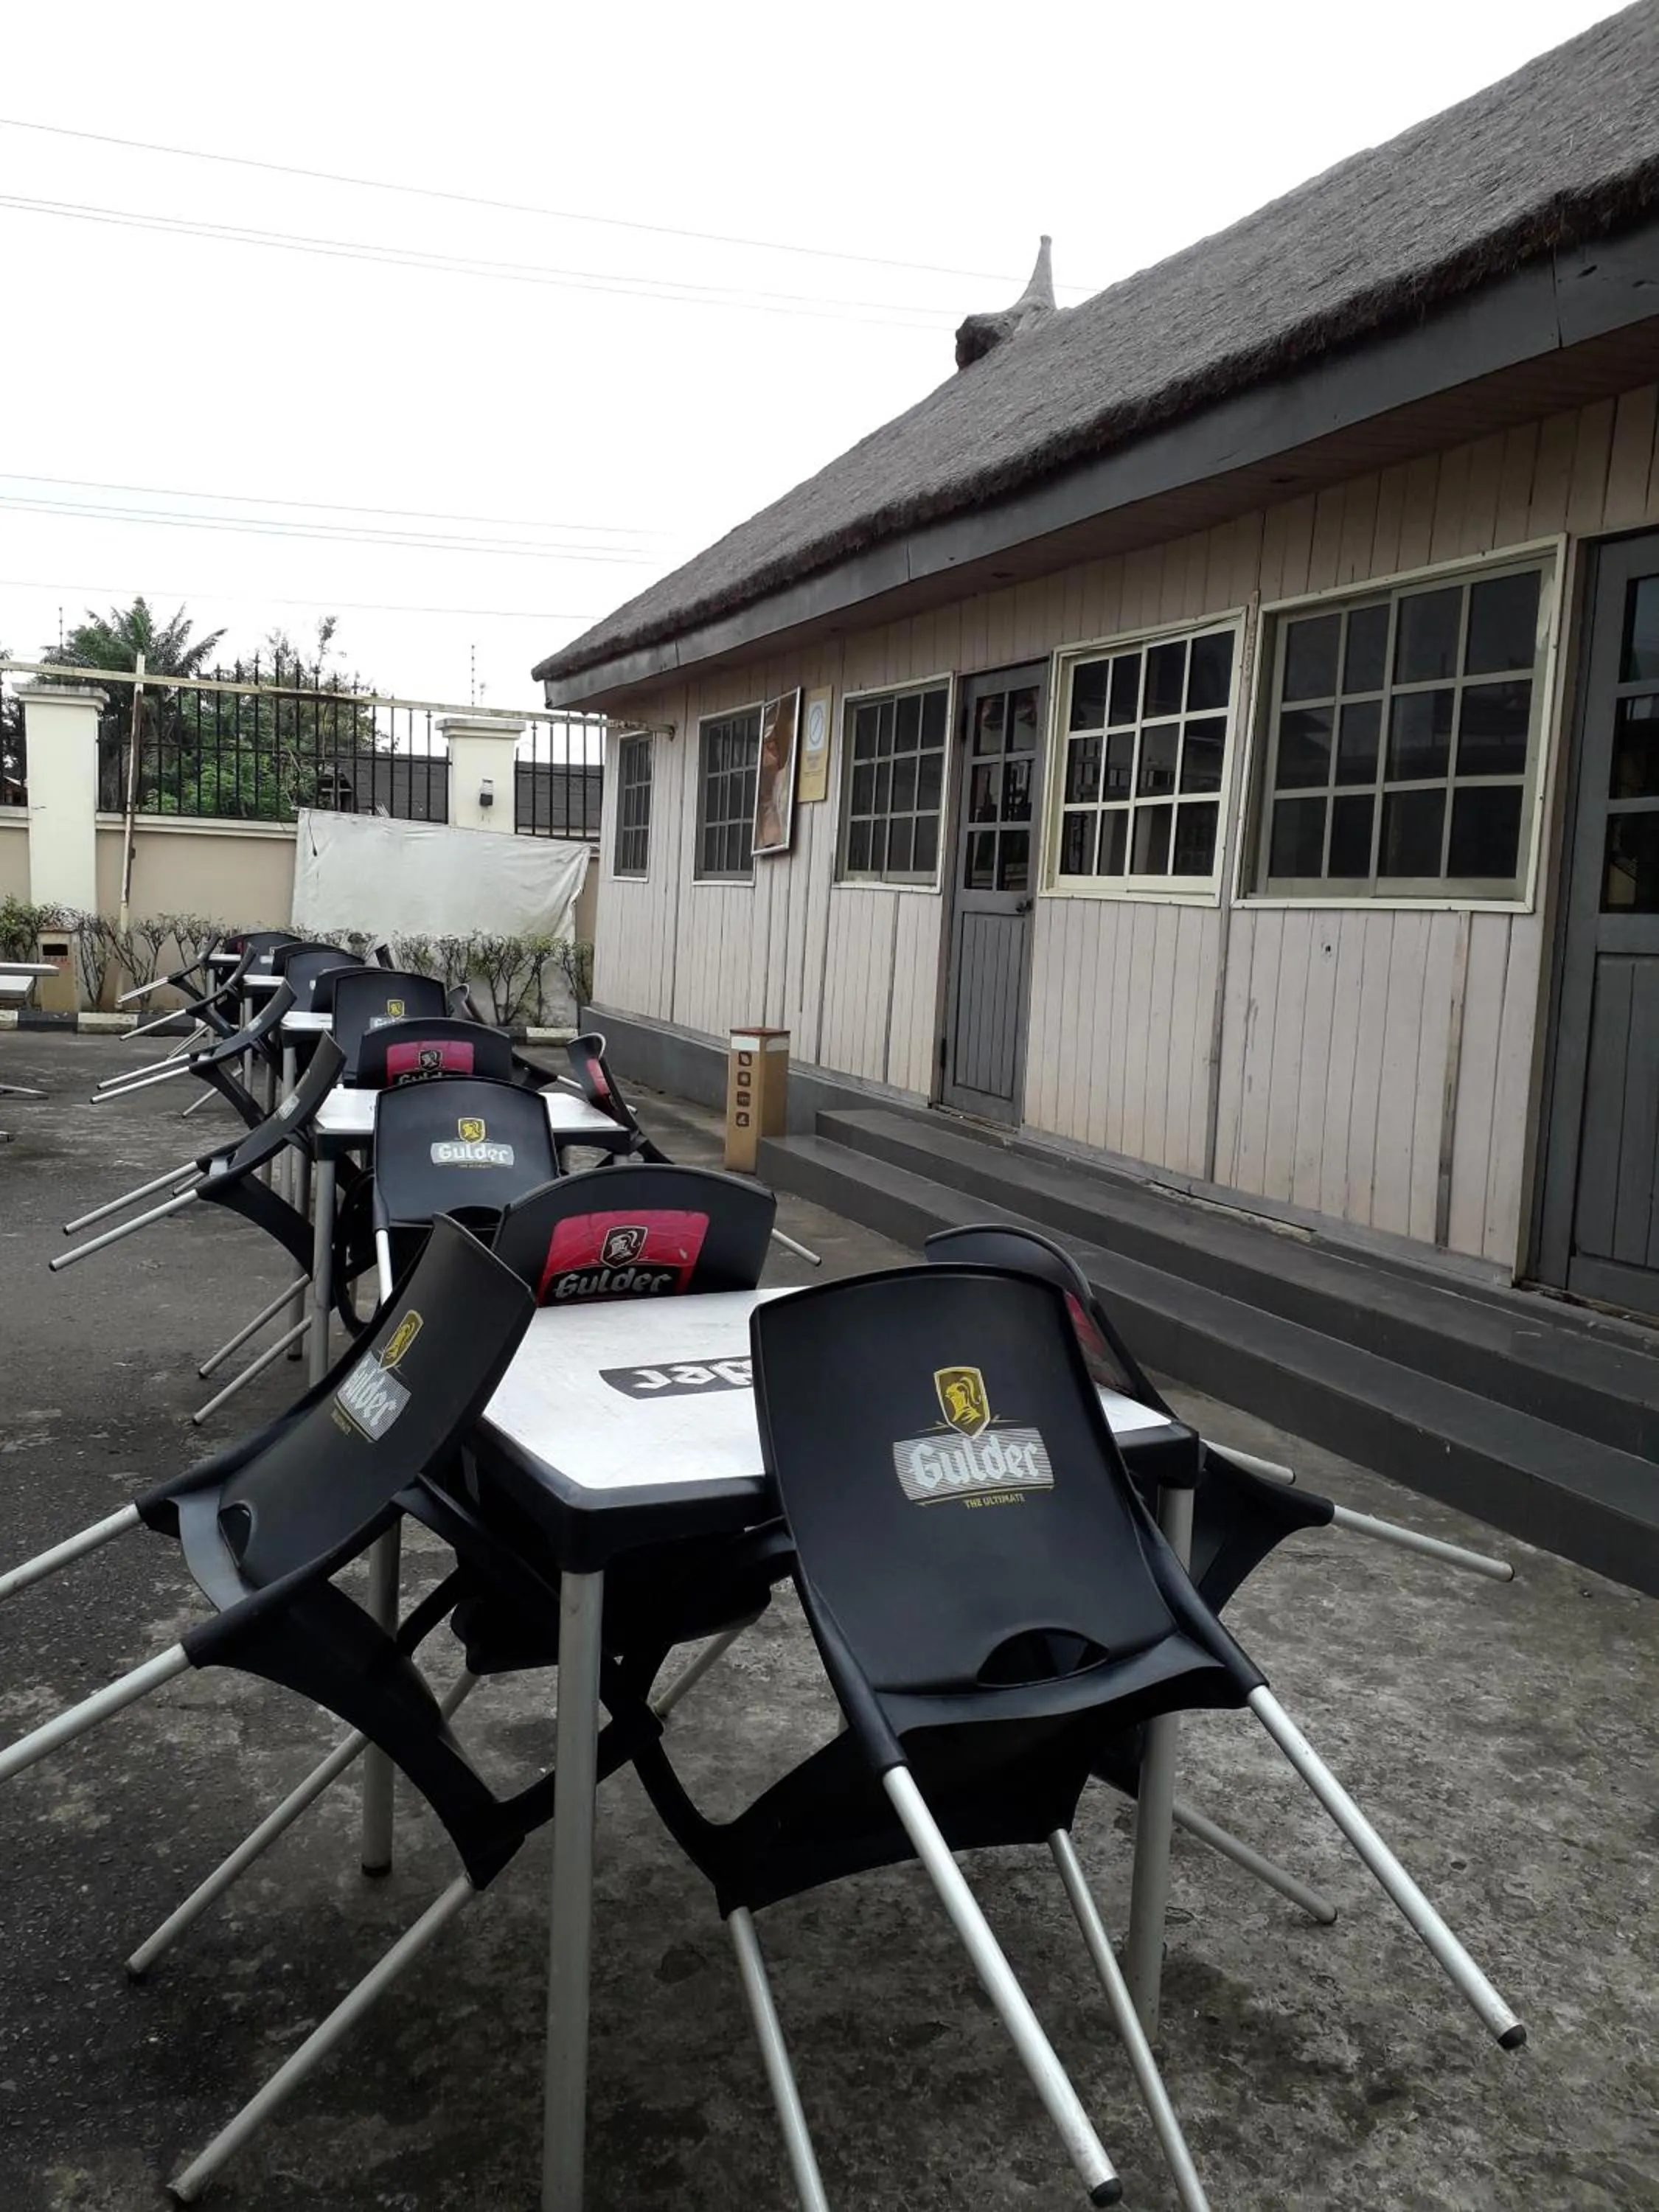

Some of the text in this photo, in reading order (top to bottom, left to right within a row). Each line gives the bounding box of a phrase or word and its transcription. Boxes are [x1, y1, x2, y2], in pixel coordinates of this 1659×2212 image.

[438, 1144, 508, 1162] Gulder
[554, 1267, 672, 1298] Gulder
[909, 1434, 1038, 1489] Gulder
[962, 1493, 1026, 1509] THE ULTIMATE
